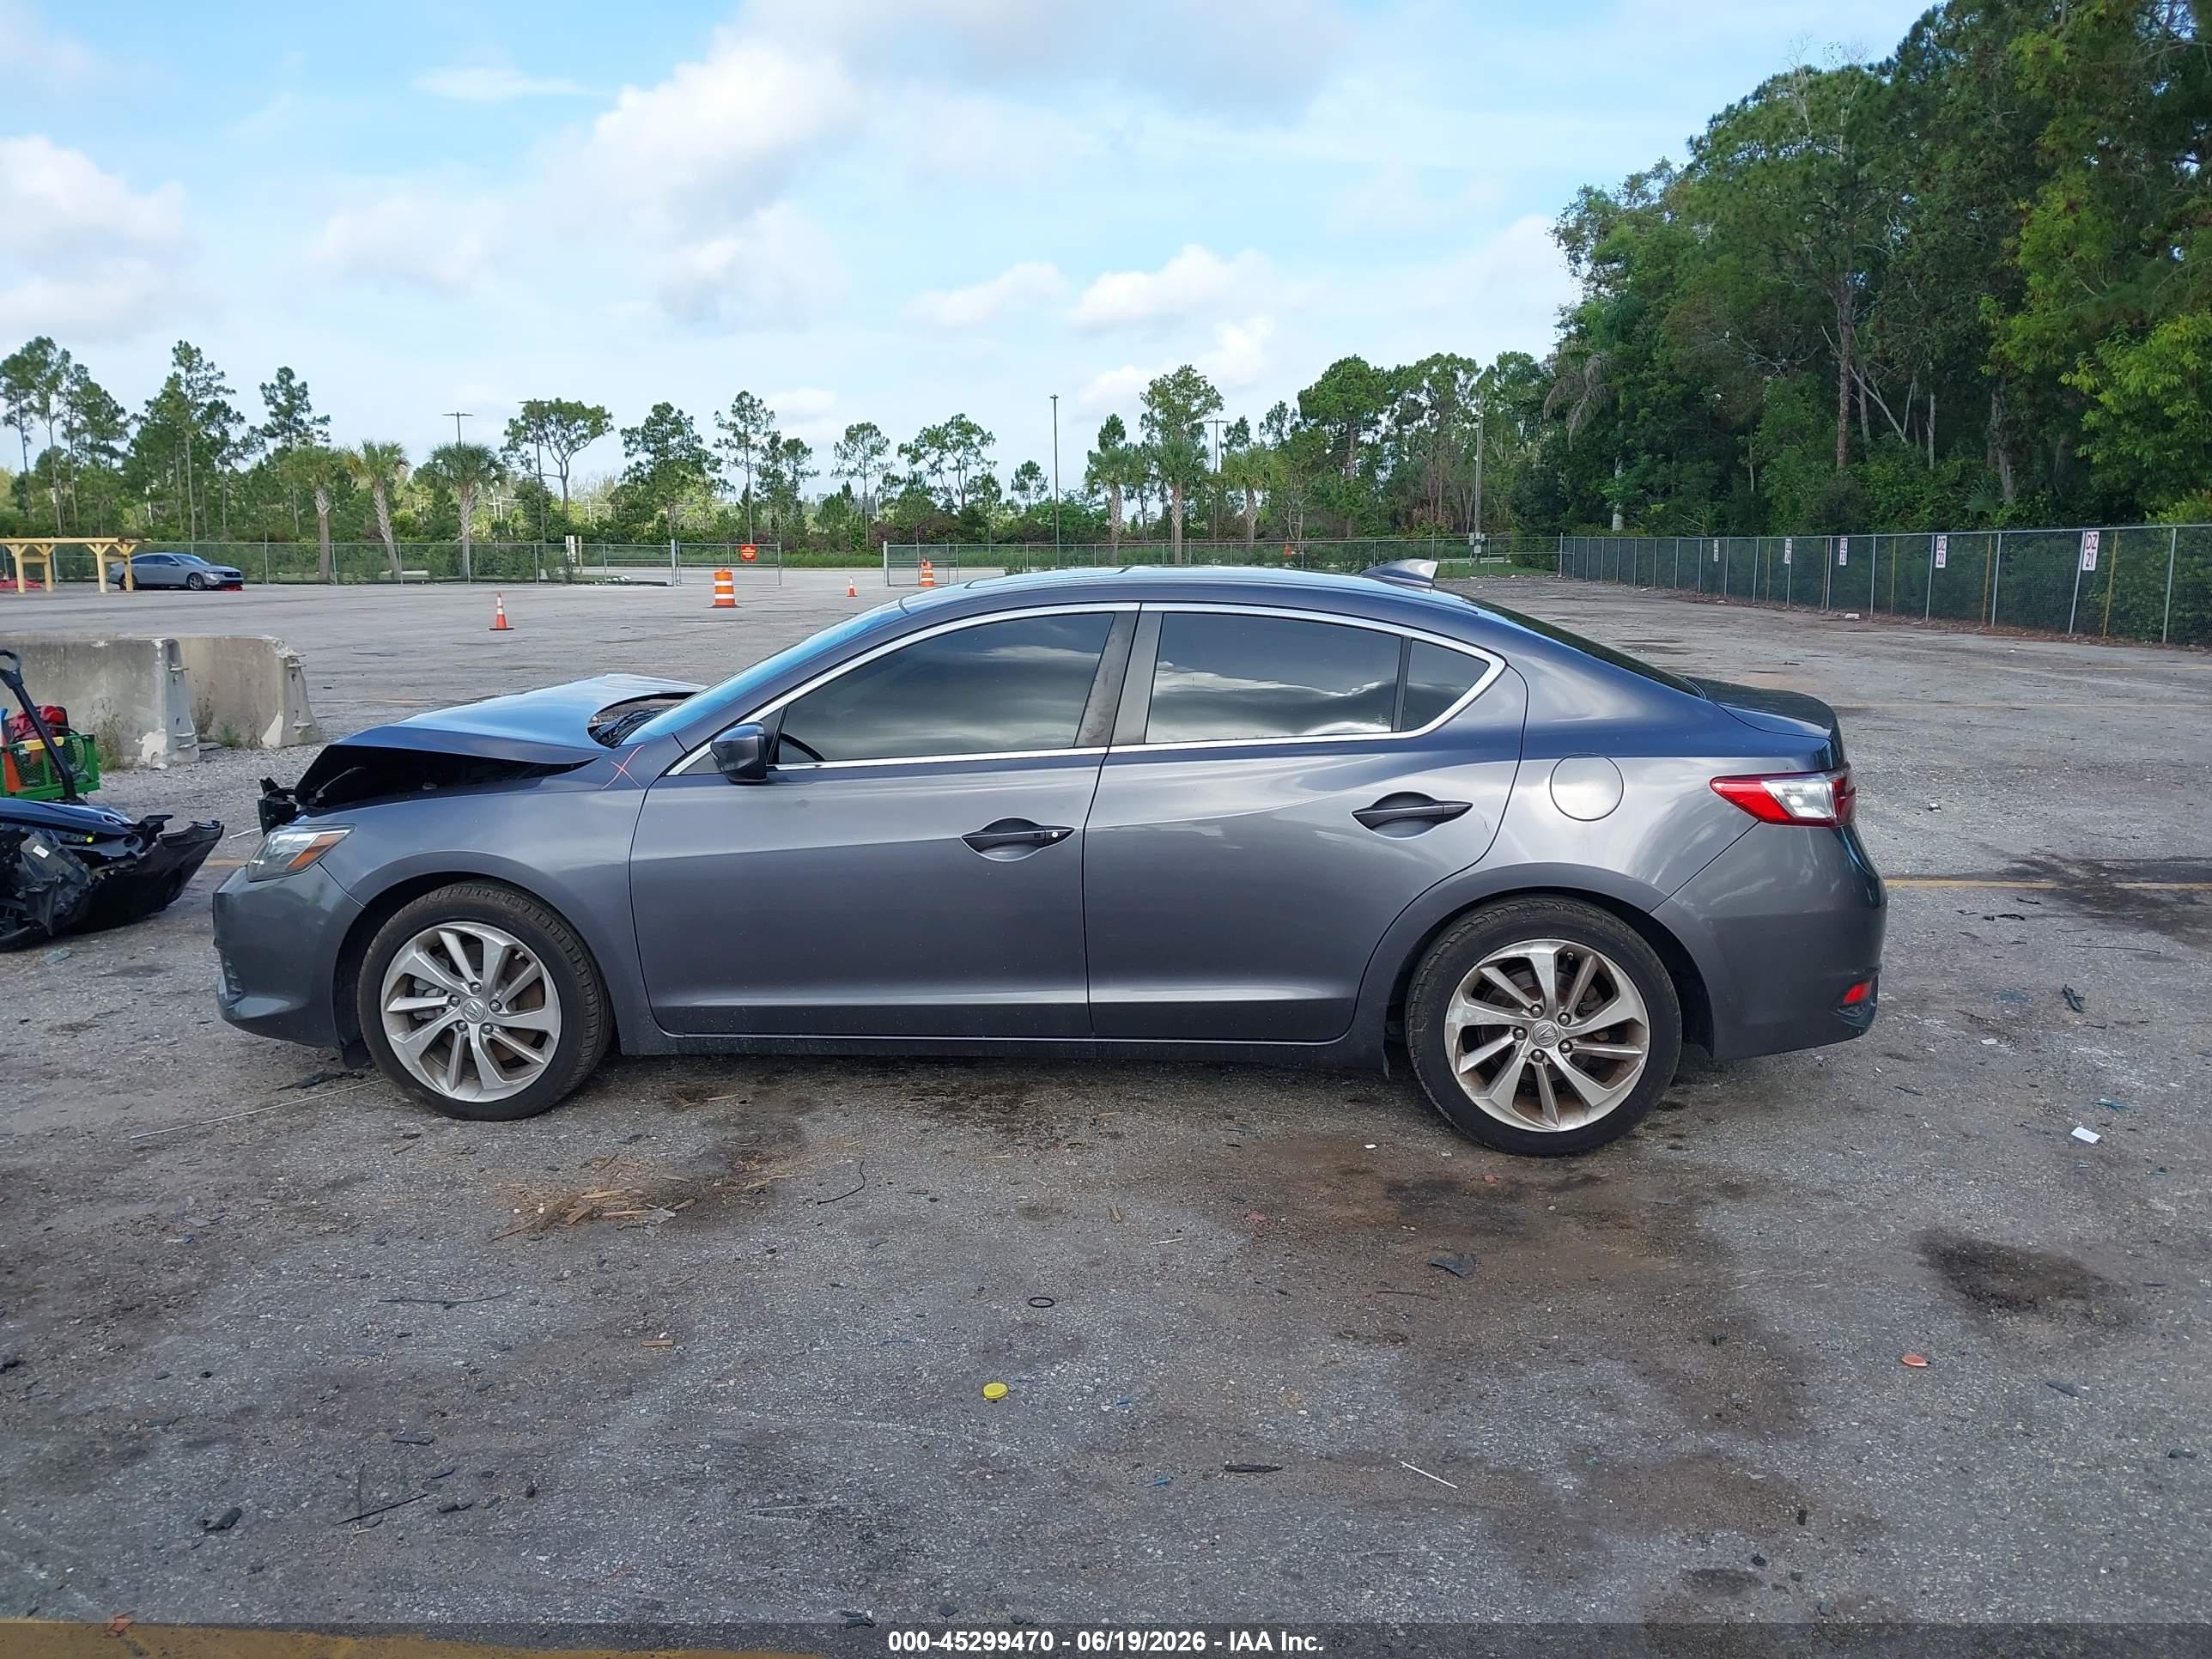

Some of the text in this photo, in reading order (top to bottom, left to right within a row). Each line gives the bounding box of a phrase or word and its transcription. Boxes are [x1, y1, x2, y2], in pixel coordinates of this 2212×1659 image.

[1937, 538, 1947, 550] DZ
[2086, 534, 2098, 550] DZ
[1937, 552, 1945, 565] 22
[2086, 552, 2094, 567] 21
